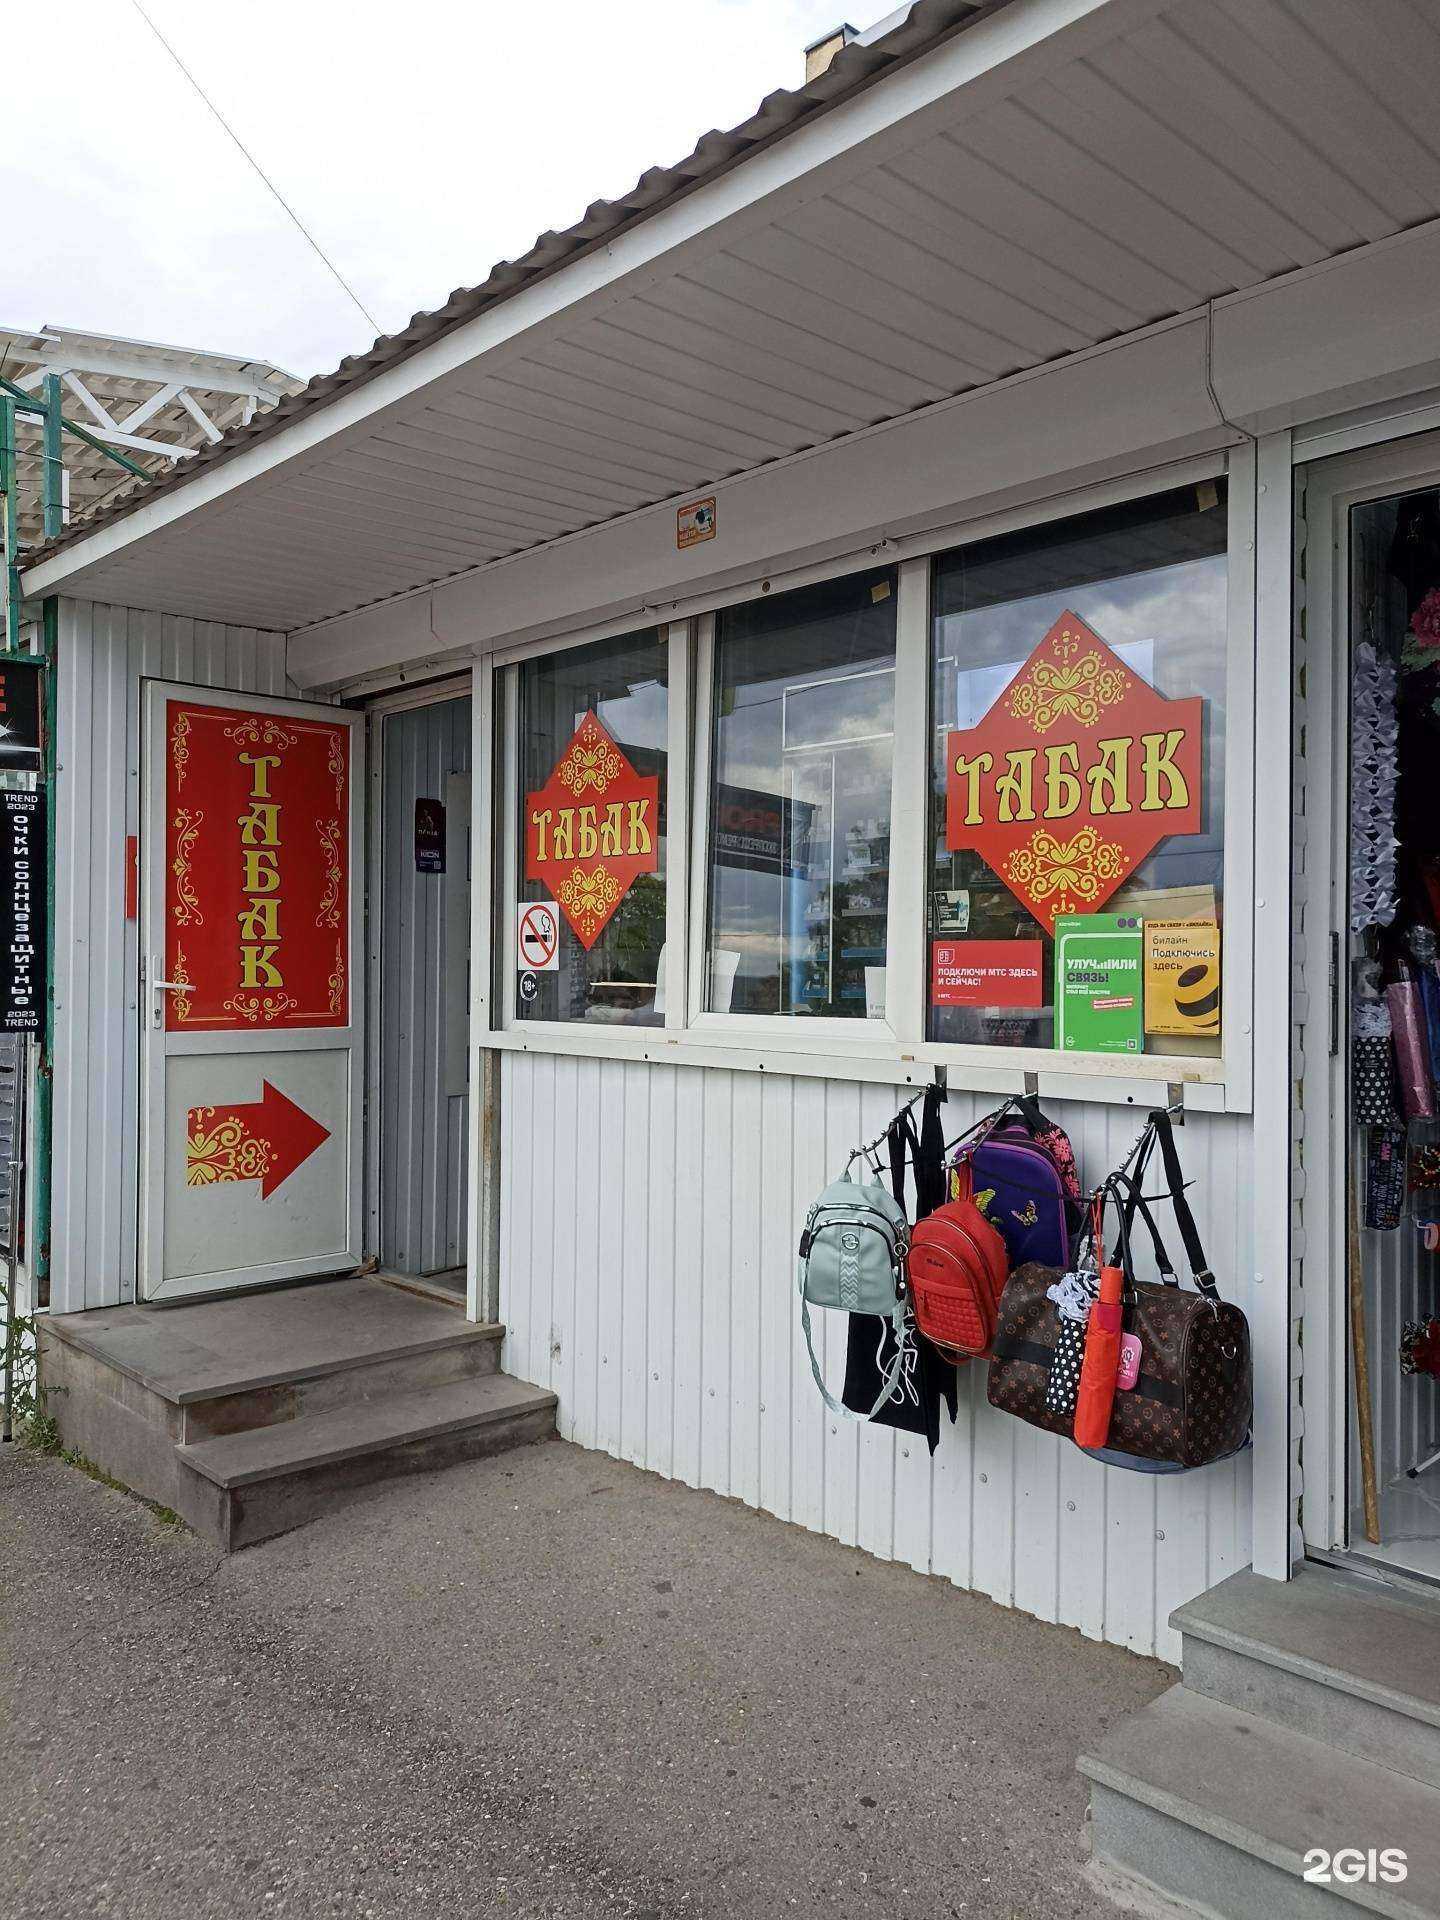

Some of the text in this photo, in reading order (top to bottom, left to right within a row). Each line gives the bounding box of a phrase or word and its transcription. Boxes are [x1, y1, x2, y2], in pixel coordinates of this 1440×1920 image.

[955, 729, 1190, 827] ТАБАК
[4, 793, 38, 803] TREND
[7, 803, 36, 811] 2023
[532, 799, 652, 861] ТАБАК
[237, 752, 284, 988] ТАБАК
[1152, 935, 1188, 946] билайн
[1152, 949, 1215, 959] Подключись
[1152, 963, 1183, 972] здесь
[937, 968, 1038, 978] ПОДКЛЮЧИ МТС ЗДЕСЬ
[1067, 972, 1109, 983] СВЯЗЬ!
[937, 976, 981, 986] И СЕЙЧАС!
[523, 981, 536, 992] 18+
[7, 1010, 36, 1018] 2023
[5, 1018, 39, 1027] TREND
